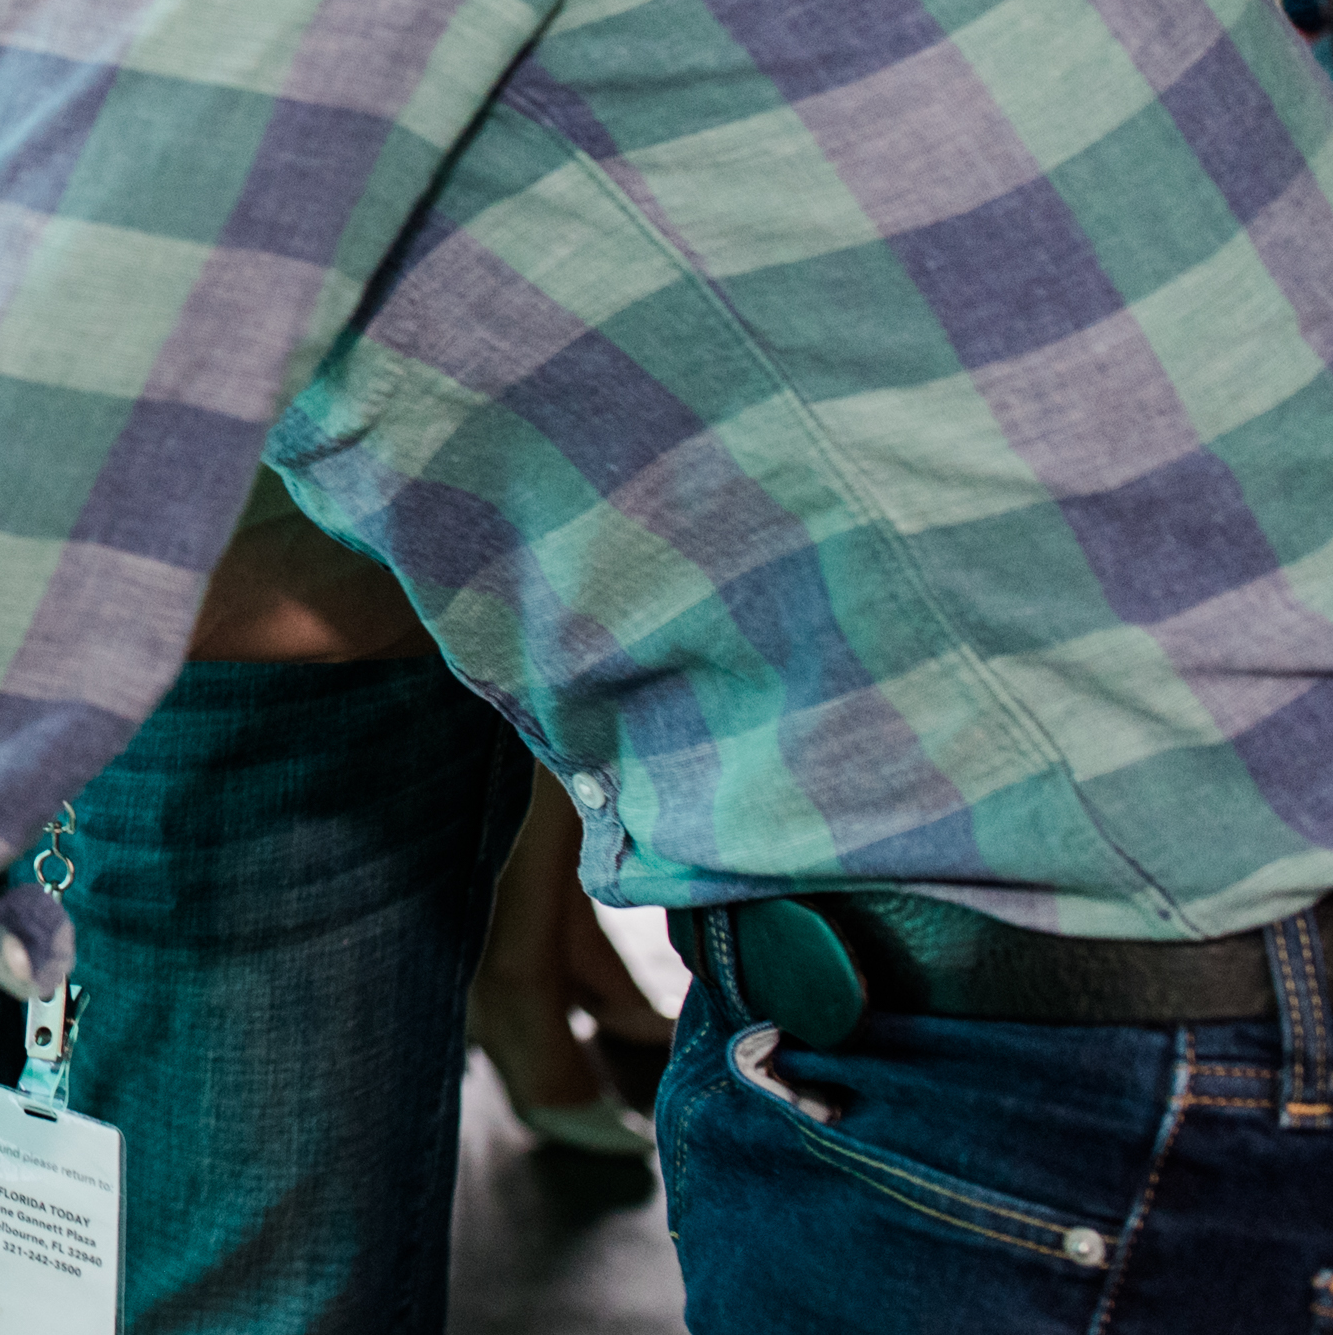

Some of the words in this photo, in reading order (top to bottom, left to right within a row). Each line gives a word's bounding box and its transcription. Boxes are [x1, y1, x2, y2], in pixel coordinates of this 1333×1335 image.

[22, 1151, 59, 1173] please
[61, 1167, 96, 1186] return
[17, 1210, 64, 1236] Gannett
[66, 1228, 97, 1248] Plaza
[50, 1205, 91, 1228] TODAY
[2, 1240, 82, 1278] 321-242-3500
[51, 1240, 65, 1254] FL
[67, 1246, 103, 1267] 32940
